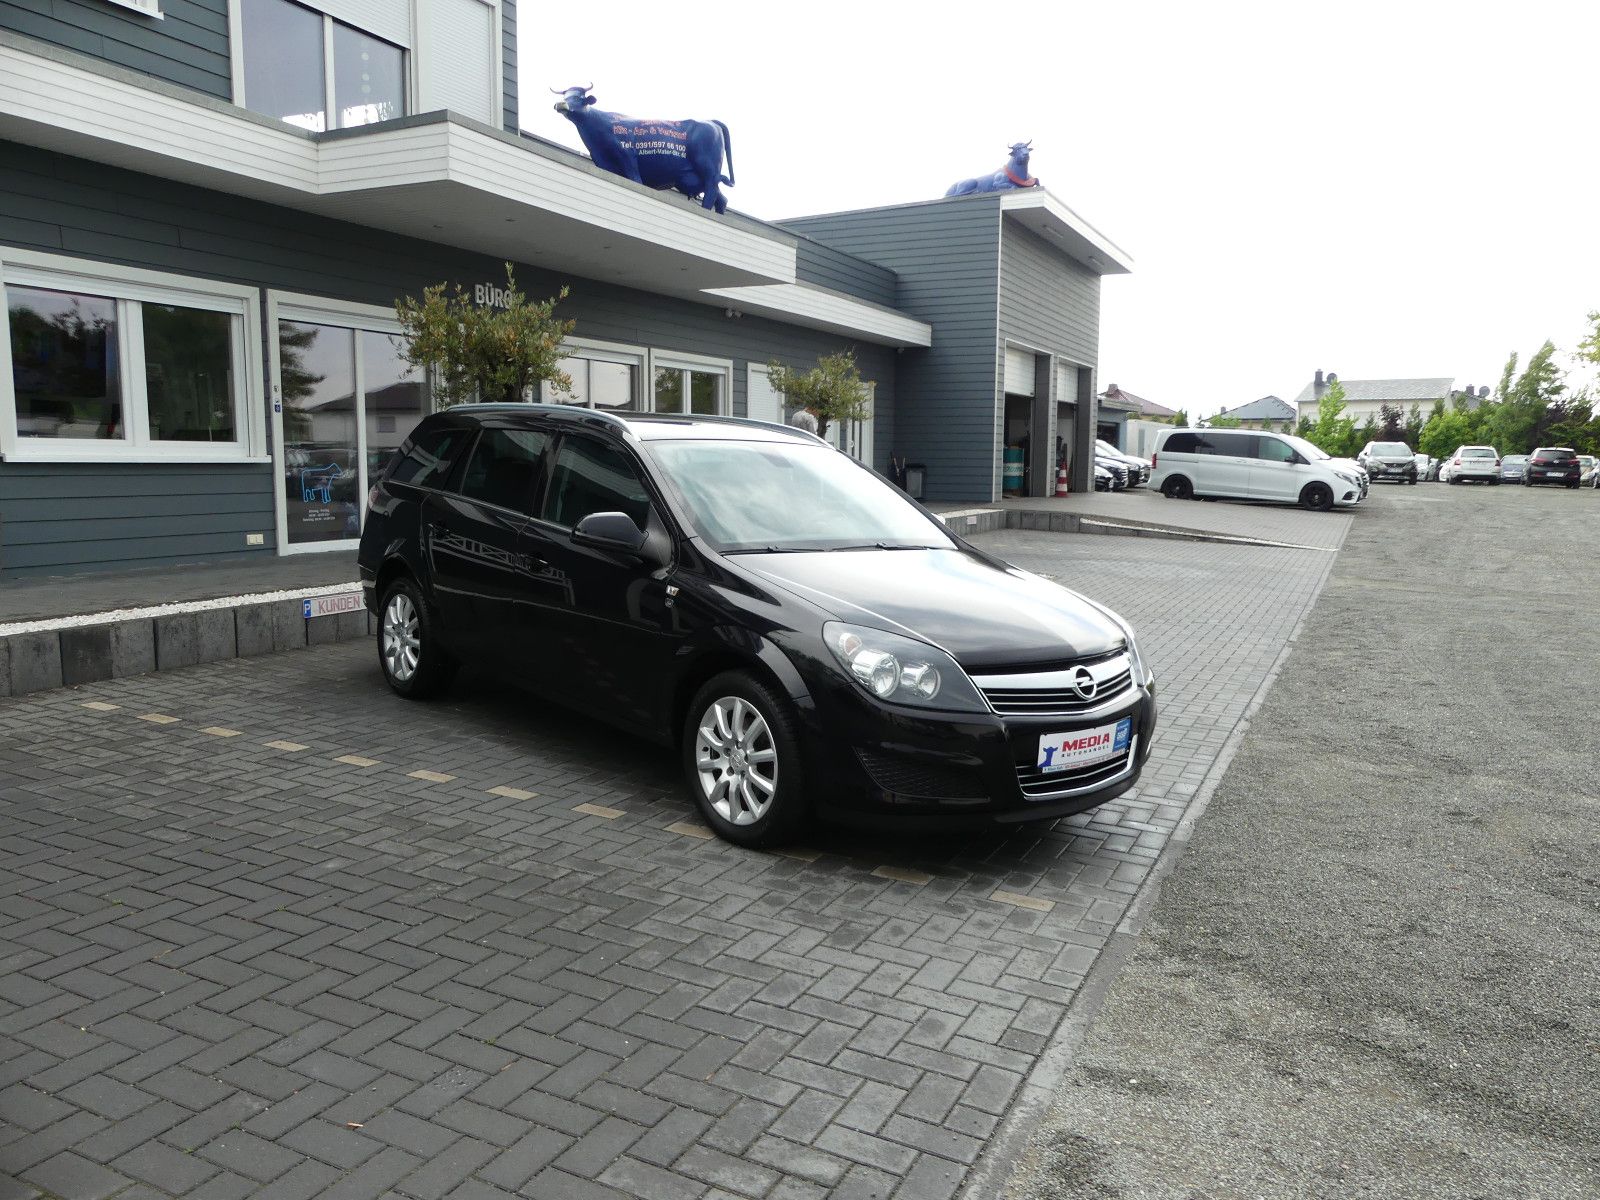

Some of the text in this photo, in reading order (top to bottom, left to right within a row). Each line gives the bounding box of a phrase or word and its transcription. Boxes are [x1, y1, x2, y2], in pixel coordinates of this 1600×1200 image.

[621, 141, 634, 149] Tel.
[635, 141, 666, 149] 0391/597
[475, 282, 513, 309] BÜRO
[304, 596, 361, 614] P KUNDEN
[1061, 744, 1110, 758] AUTOHANDEL
[1062, 732, 1110, 752] MEDIA
